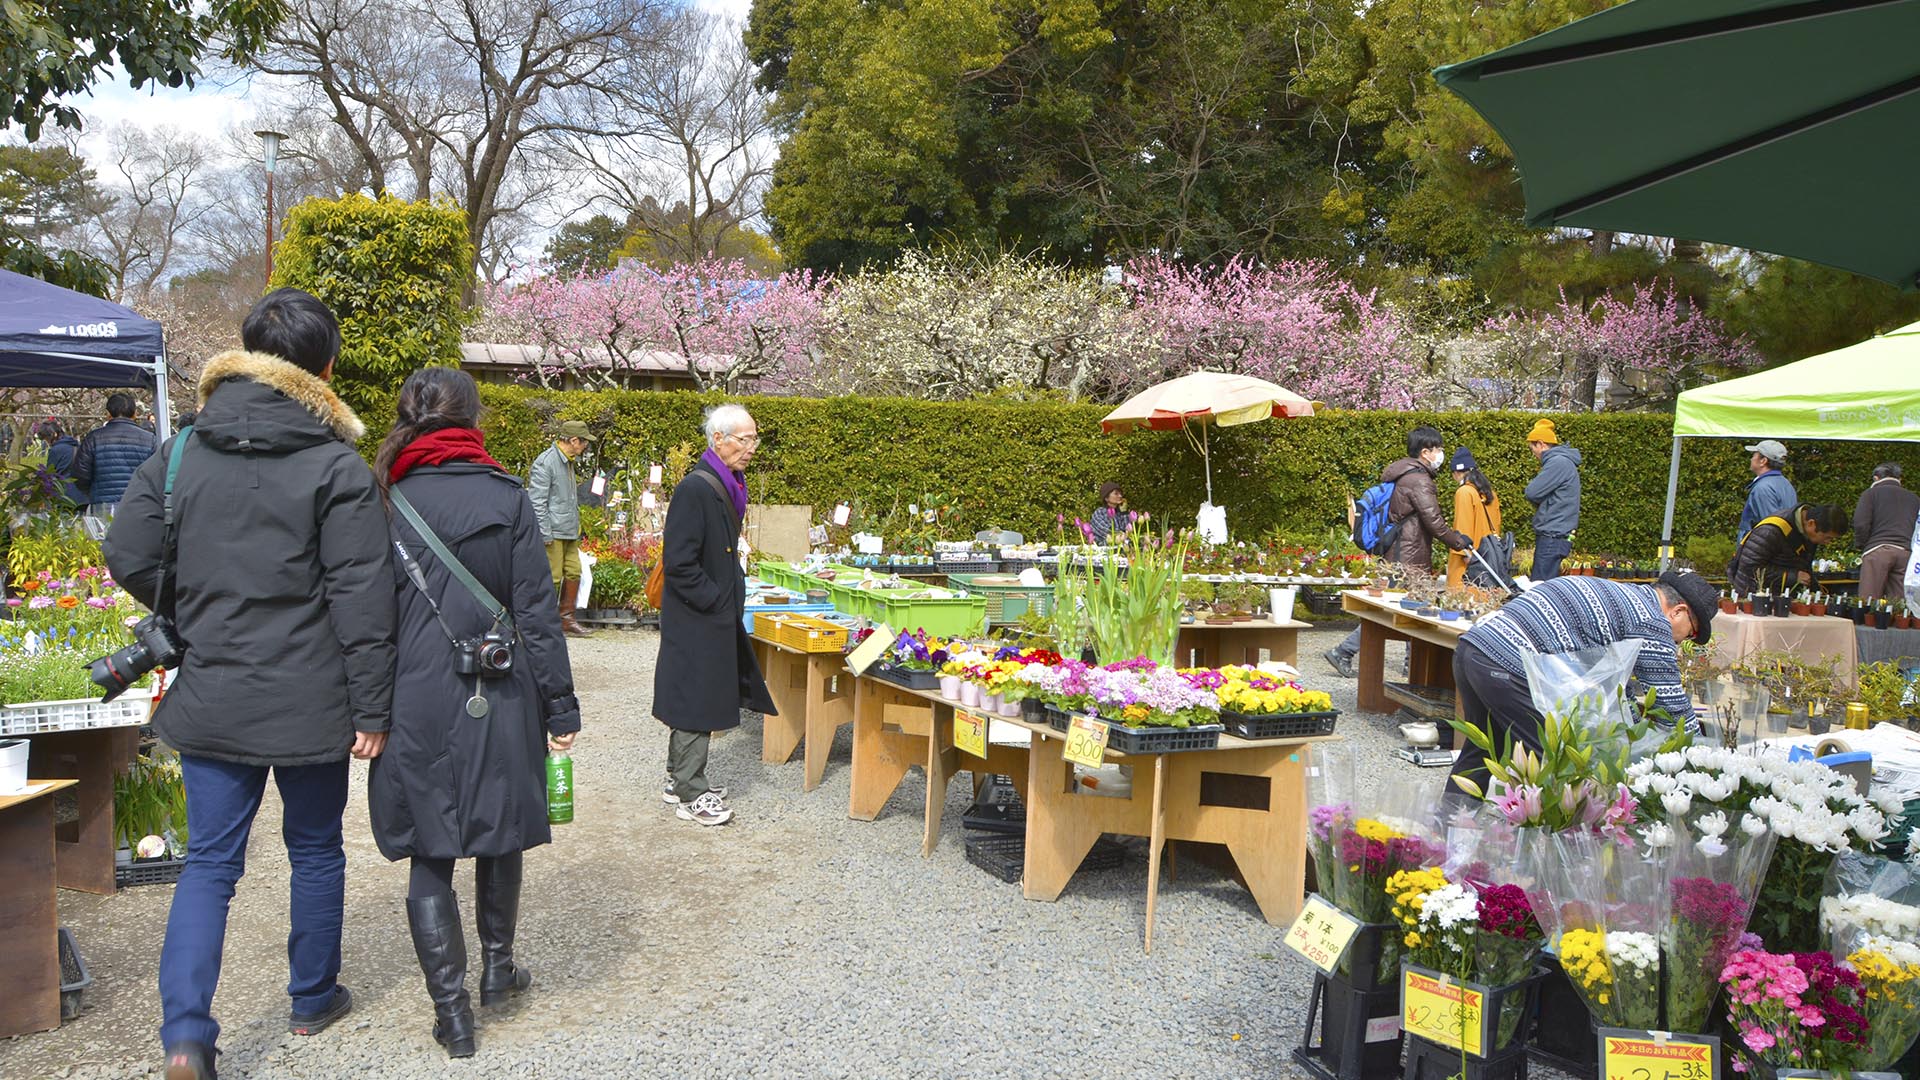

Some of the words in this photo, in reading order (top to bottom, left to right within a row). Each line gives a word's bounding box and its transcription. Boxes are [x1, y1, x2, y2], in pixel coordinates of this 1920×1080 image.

[69, 321, 118, 338] LOGOS
[395, 541, 409, 560] SONY
[555, 768, 568, 794] 生茶
[1294, 926, 1310, 940] 3本
[1317, 920, 1333, 935] 1本
[1302, 943, 1329, 965] ¥250
[1320, 937, 1339, 954] ¥100
[1630, 1045, 1687, 1057] 本日のお買得品
[1681, 1061, 1709, 1080] 3本
